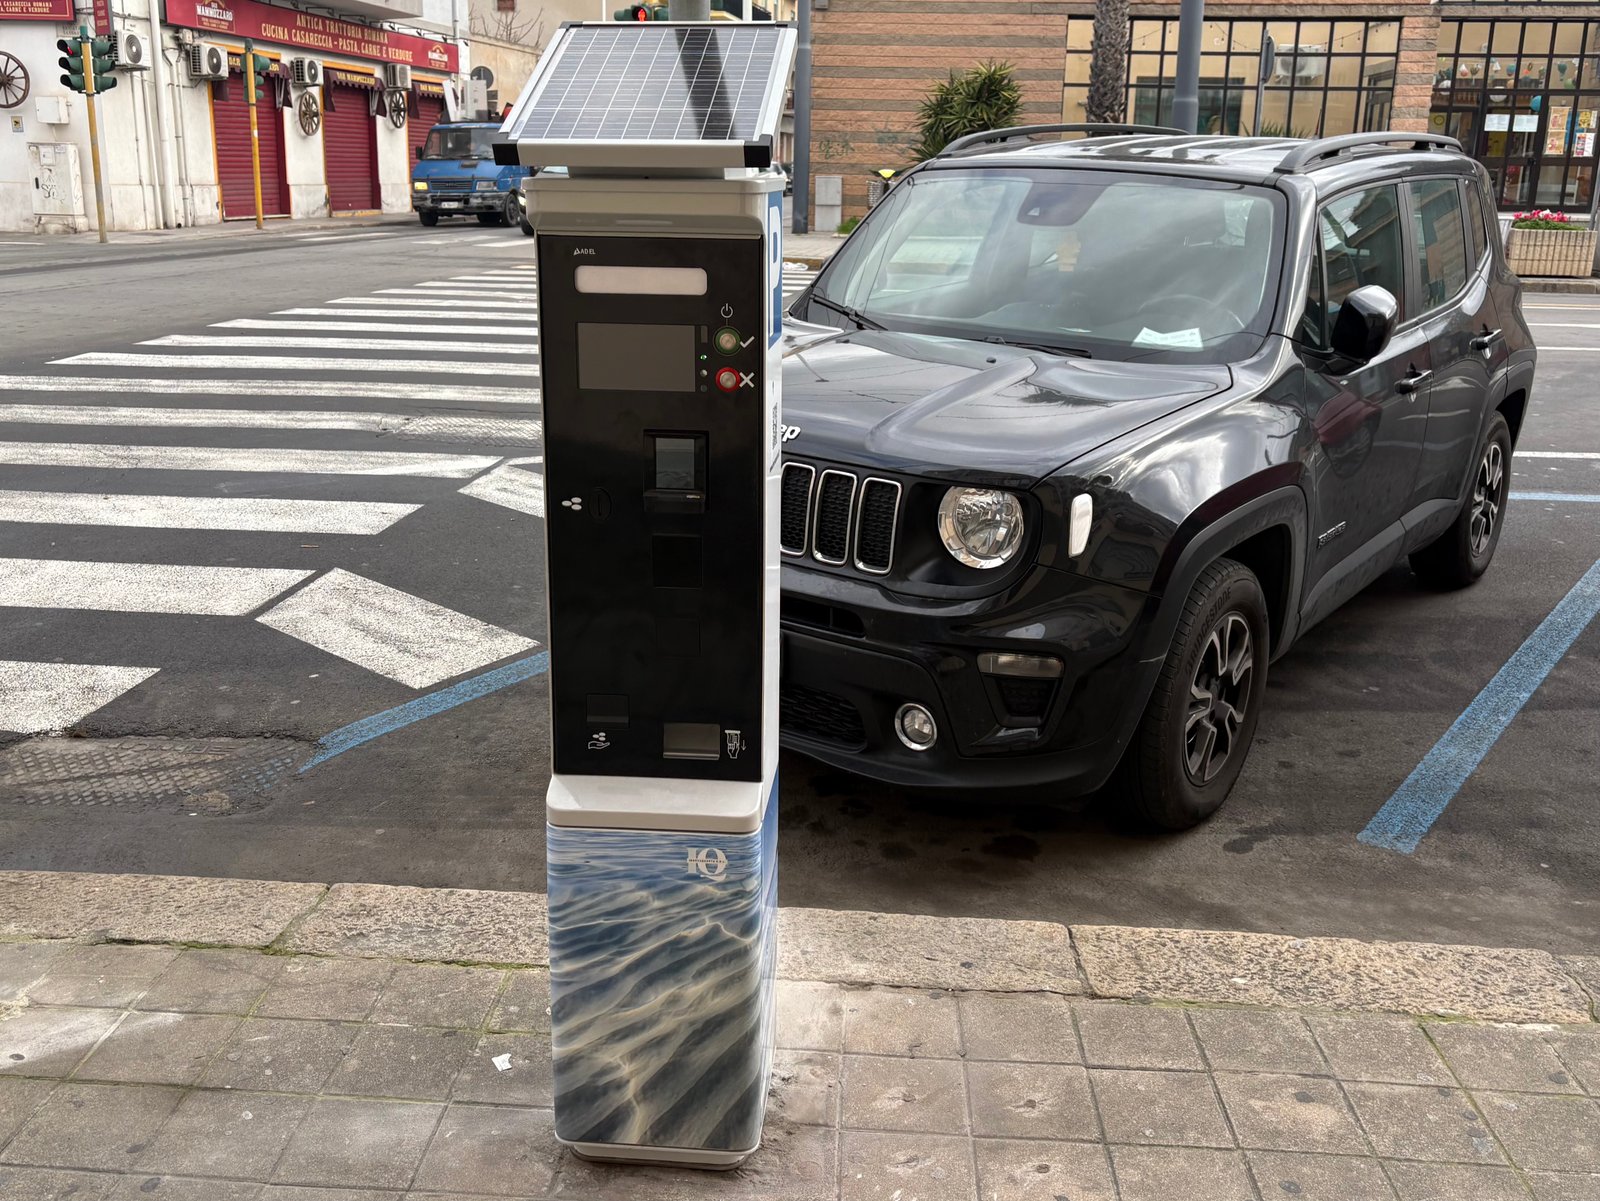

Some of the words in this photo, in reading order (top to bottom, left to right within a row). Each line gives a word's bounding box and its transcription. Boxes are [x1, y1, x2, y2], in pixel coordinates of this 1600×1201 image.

[261, 23, 289, 41] CUCINA
[291, 29, 333, 48] CASARECCIA
[338, 38, 360, 54] PASTA,
[361, 43, 381, 57] CARNE
[382, 46, 387, 58] E
[388, 47, 413, 62] VERDURE
[296, 14, 323, 31] ANTICA
[326, 20, 362, 39] TRATTORIA
[364, 29, 388, 44] ROMANA
